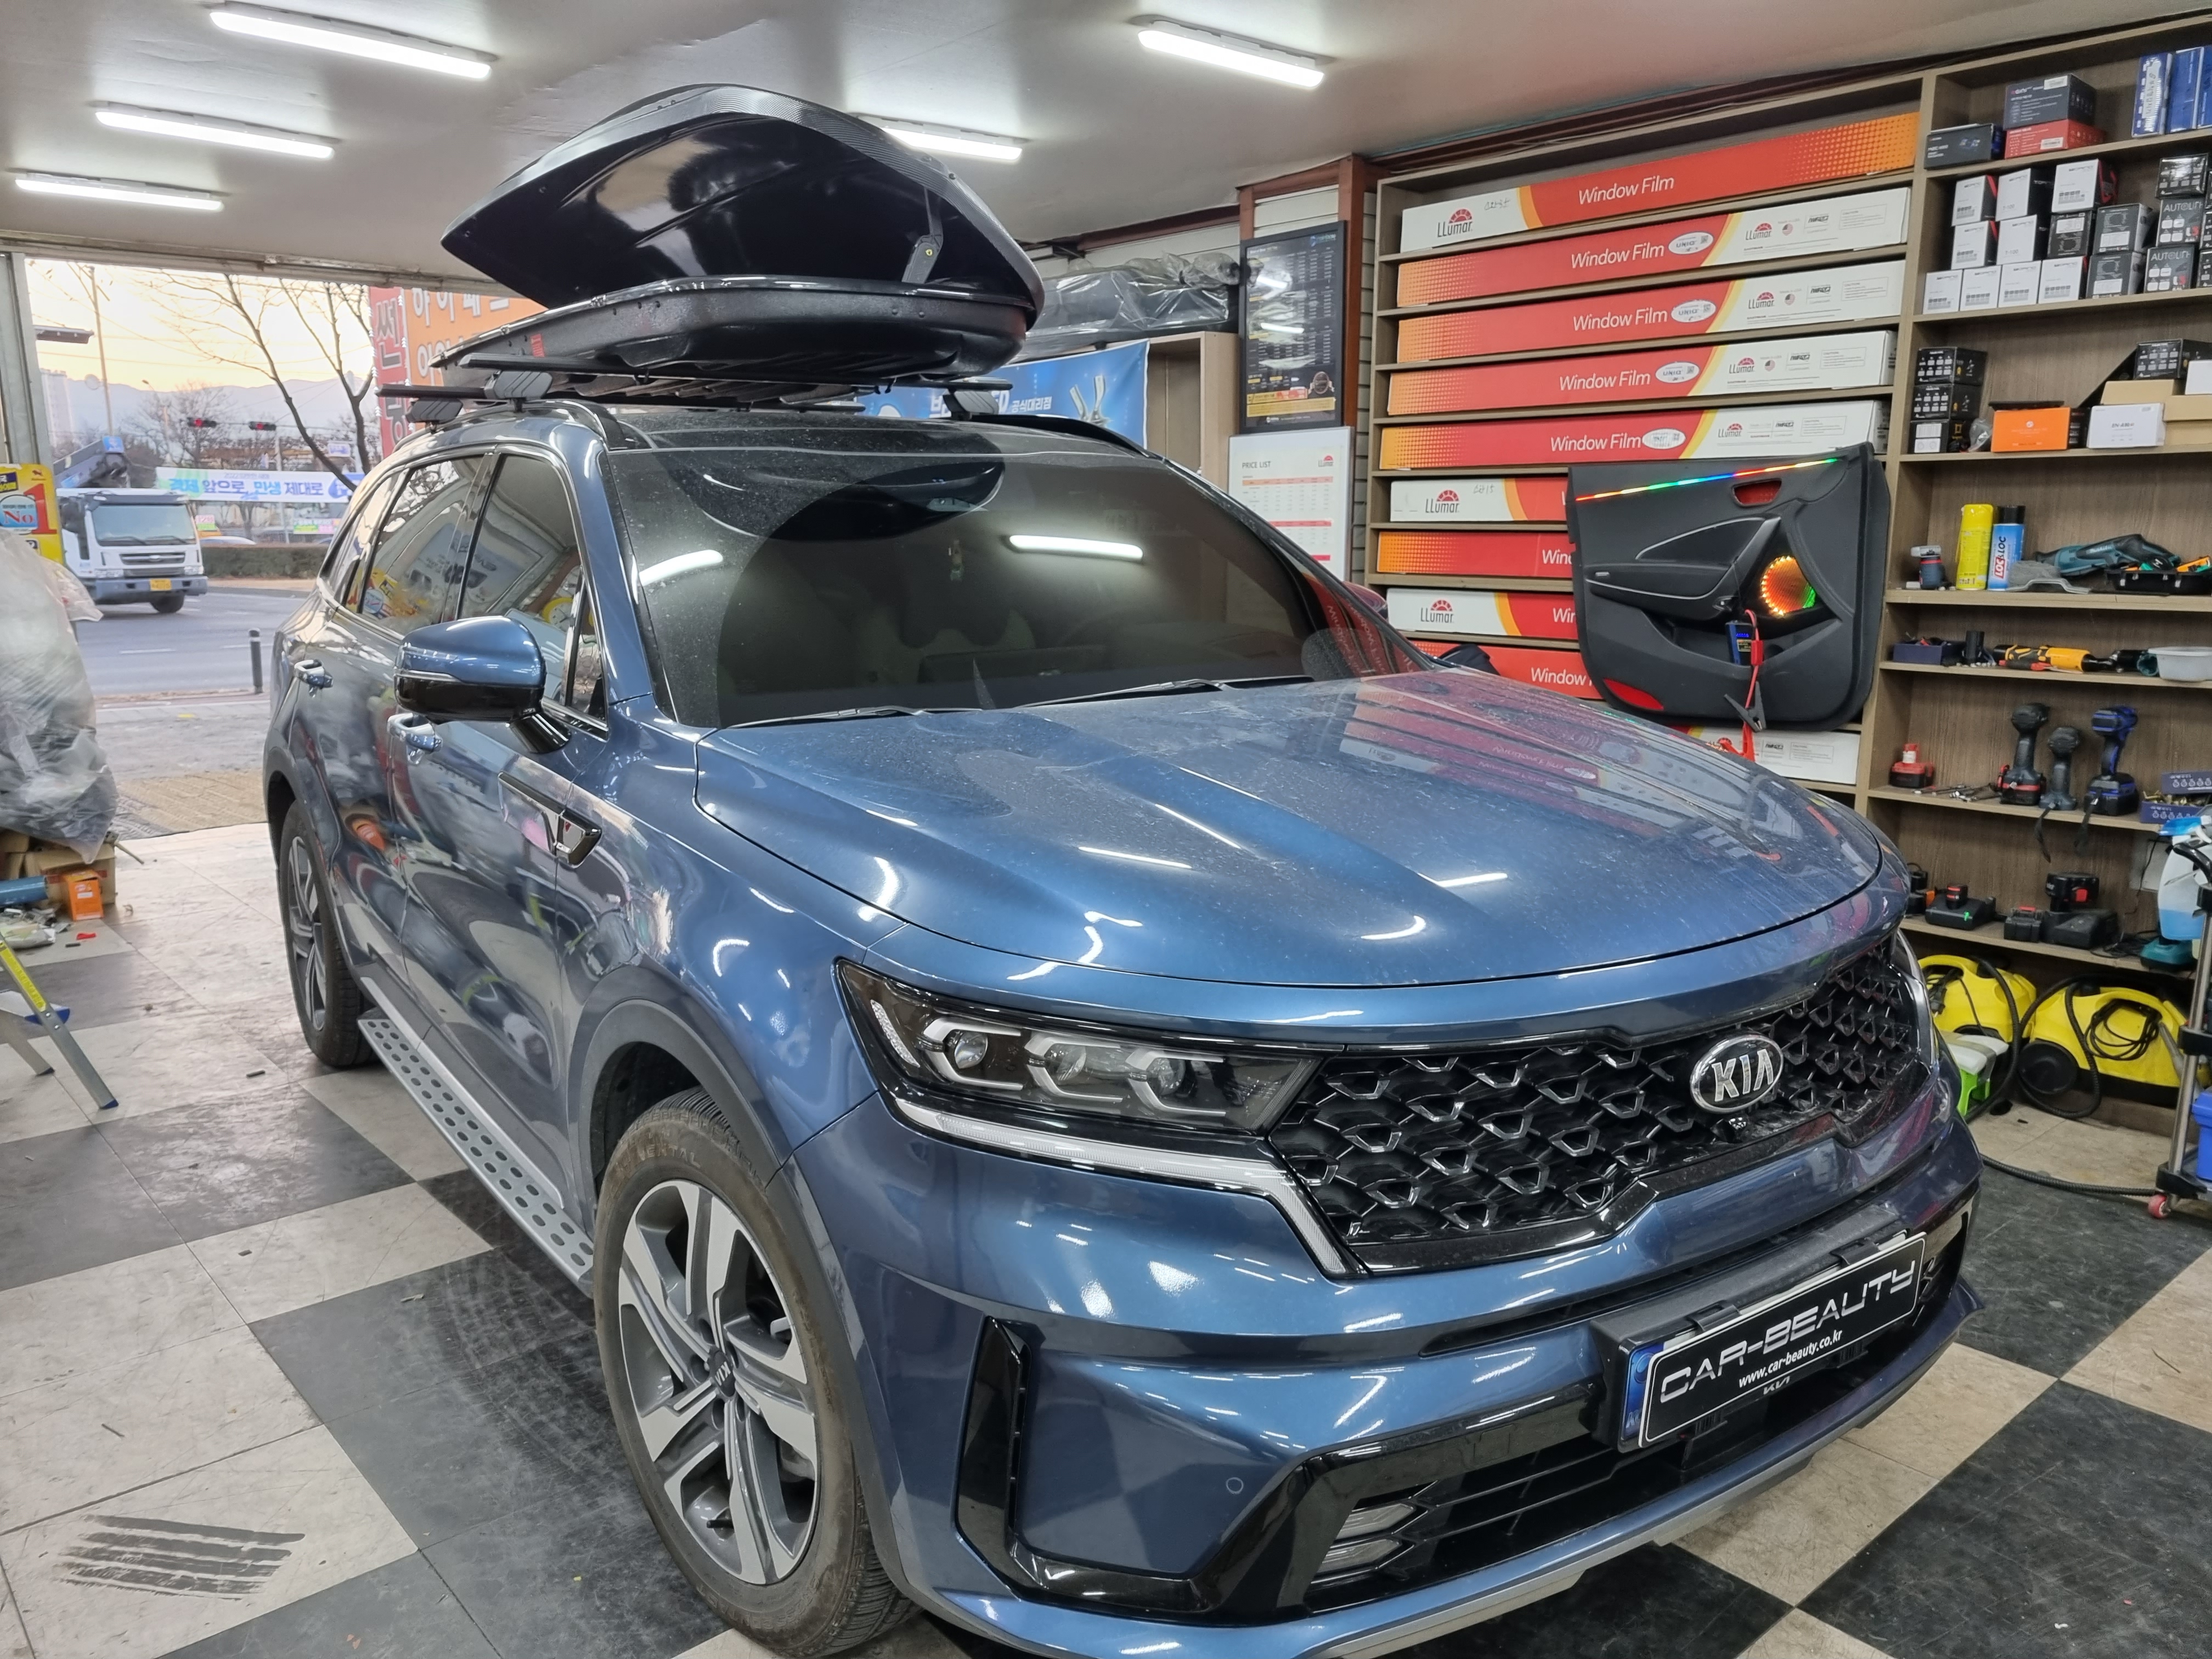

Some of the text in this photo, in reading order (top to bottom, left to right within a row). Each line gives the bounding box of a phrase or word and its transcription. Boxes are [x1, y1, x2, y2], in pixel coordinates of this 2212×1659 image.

[1578, 175, 1674, 205] Window Film
[1437, 220, 1472, 238] LLumar
[1745, 229, 1772, 240] LLumar
[1571, 242, 1665, 268] Window Film
[1748, 299, 1775, 309] LLumar
[1573, 307, 1668, 331] Window Film
[1729, 364, 1754, 374] LLumar
[1560, 370, 1651, 391] Window Film
[1012, 396, 1052, 413] 공식대리점
[1550, 432, 1641, 452] Window Film
[284, 481, 324, 496] 제대로
[1425, 498, 1459, 514] LLumar
[1420, 607, 1454, 623] LLumar
[1531, 667, 1587, 685] Window
[1711, 1048, 1774, 1102] KIA
[1660, 1260, 1916, 1403] CAR-BEAUTY
[1739, 1329, 1843, 1389] www.car-beauty.co.kr
